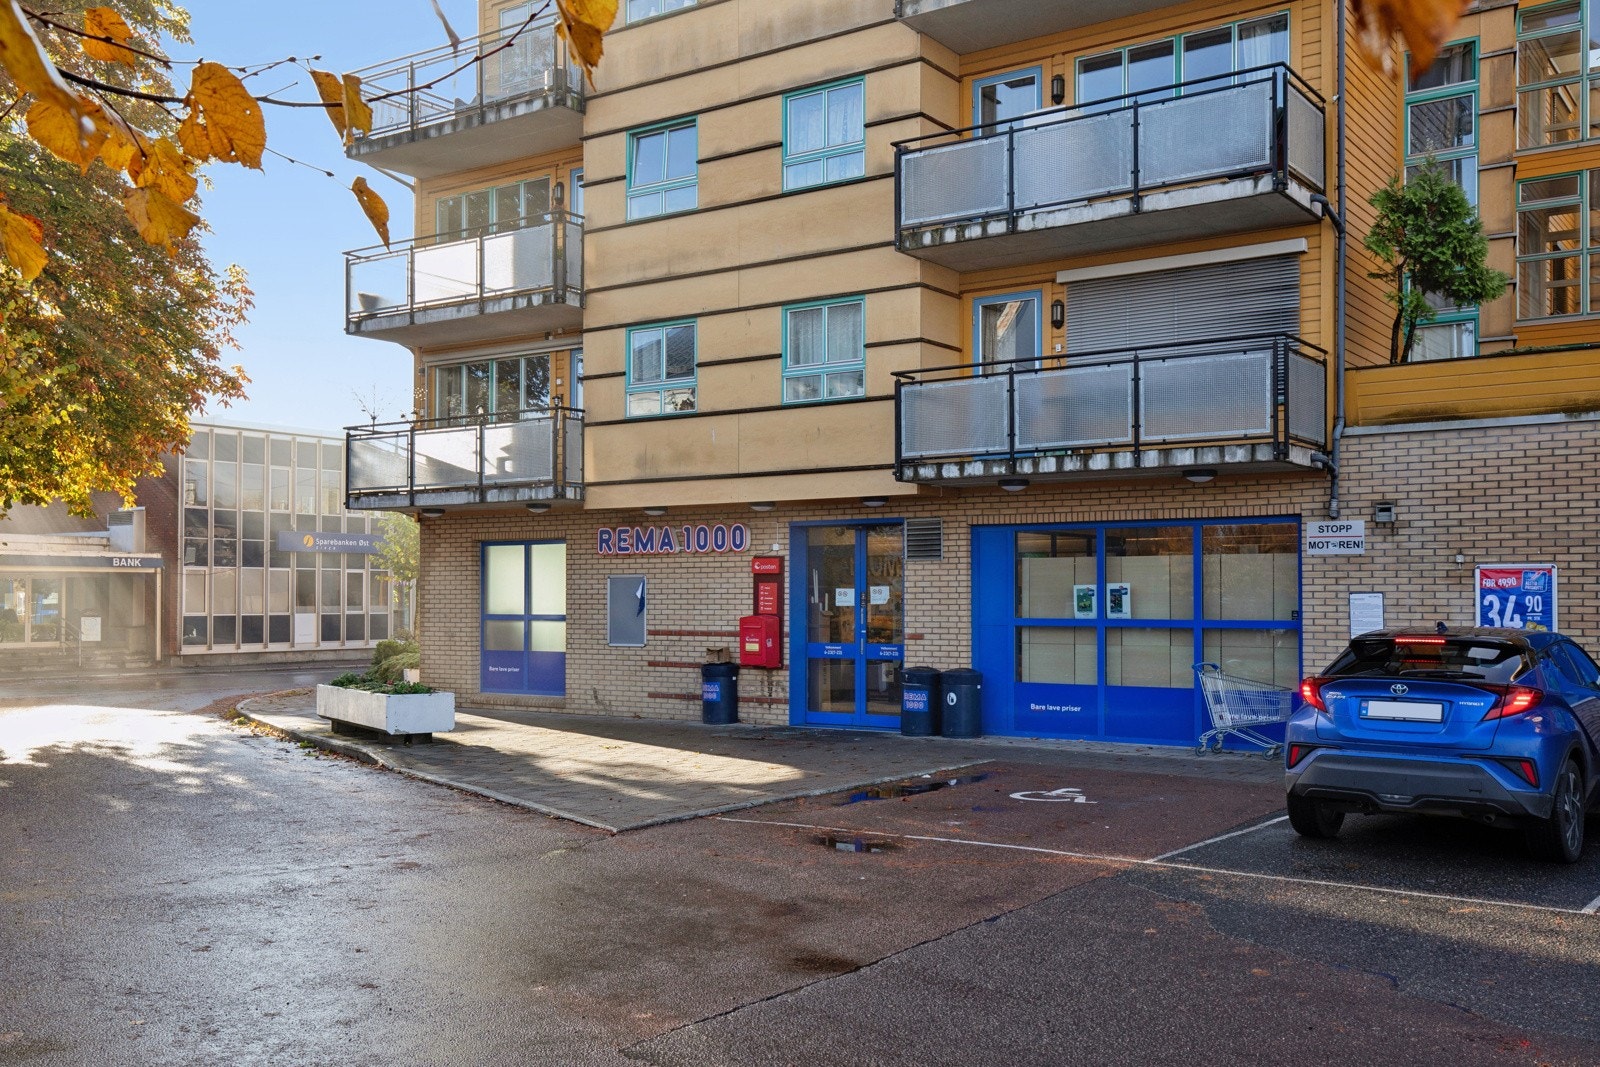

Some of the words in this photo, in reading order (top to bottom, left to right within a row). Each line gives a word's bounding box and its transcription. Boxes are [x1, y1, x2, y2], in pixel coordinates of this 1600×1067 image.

[1318, 524, 1353, 534] STOPP
[316, 538, 357, 547] Sparebanken
[358, 539, 370, 547] Øst
[597, 525, 676, 554] REMA
[682, 523, 747, 553] 1000
[112, 557, 142, 567] BANK
[760, 563, 777, 571] posten
[1482, 578, 1496, 588] FØR
[1483, 594, 1523, 629] 34
[1525, 595, 1543, 613] 90
[1030, 703, 1046, 711] Bare
[1061, 704, 1082, 713] priser
